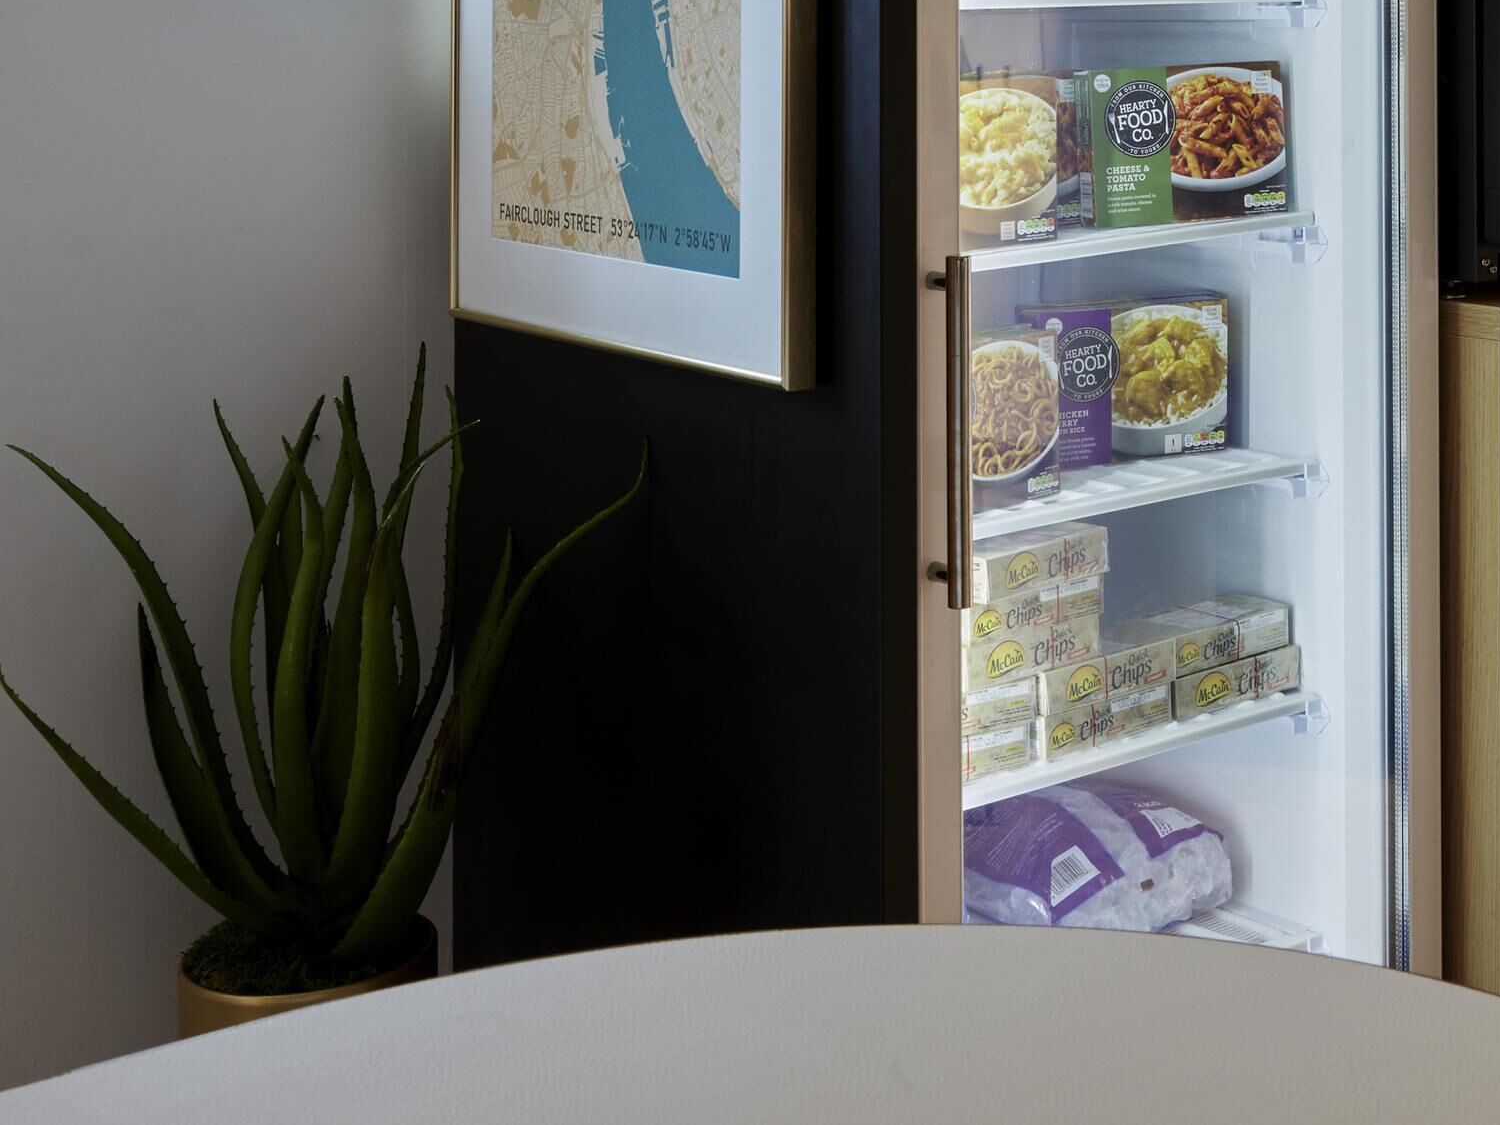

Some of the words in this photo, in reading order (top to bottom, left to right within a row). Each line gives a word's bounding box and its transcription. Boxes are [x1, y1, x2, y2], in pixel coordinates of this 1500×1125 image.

[1139, 84, 1165, 99] KITCHEN
[1119, 99, 1157, 114] HEARTY
[1117, 109, 1163, 131] FOOD
[1132, 128, 1154, 142] CO.
[1106, 165, 1142, 175] CHEESE
[1143, 164, 1150, 172] &
[1107, 173, 1146, 184] TOMATO
[1107, 183, 1136, 192] PASTA
[499, 203, 560, 229] FAIRCLOUGH
[564, 211, 603, 235] STREET
[1065, 344, 1102, 360] HEARTY
[1063, 353, 1107, 376] FOOD
[1076, 374, 1098, 388] CO.
[1059, 409, 1089, 420] HICKEN
[1069, 426, 1086, 434] RICE
[1066, 538, 1083, 550] uick
[1008, 561, 1040, 586] McCain
[1047, 547, 1086, 578] Chips
[976, 616, 1002, 635] McCain
[1006, 603, 1043, 630] Chips
[1033, 635, 1076, 667] Chips
[1178, 647, 1200, 665] McCain
[1203, 636, 1237, 661] Chips
[990, 648, 1024, 675] McCain
[1111, 659, 1153, 690] Chips
[1238, 665, 1276, 696] Chips
[1069, 673, 1102, 699] McCain
[1198, 679, 1230, 703] McCain
[1051, 727, 1076, 749] McCain
[1079, 715, 1114, 742] Chips
